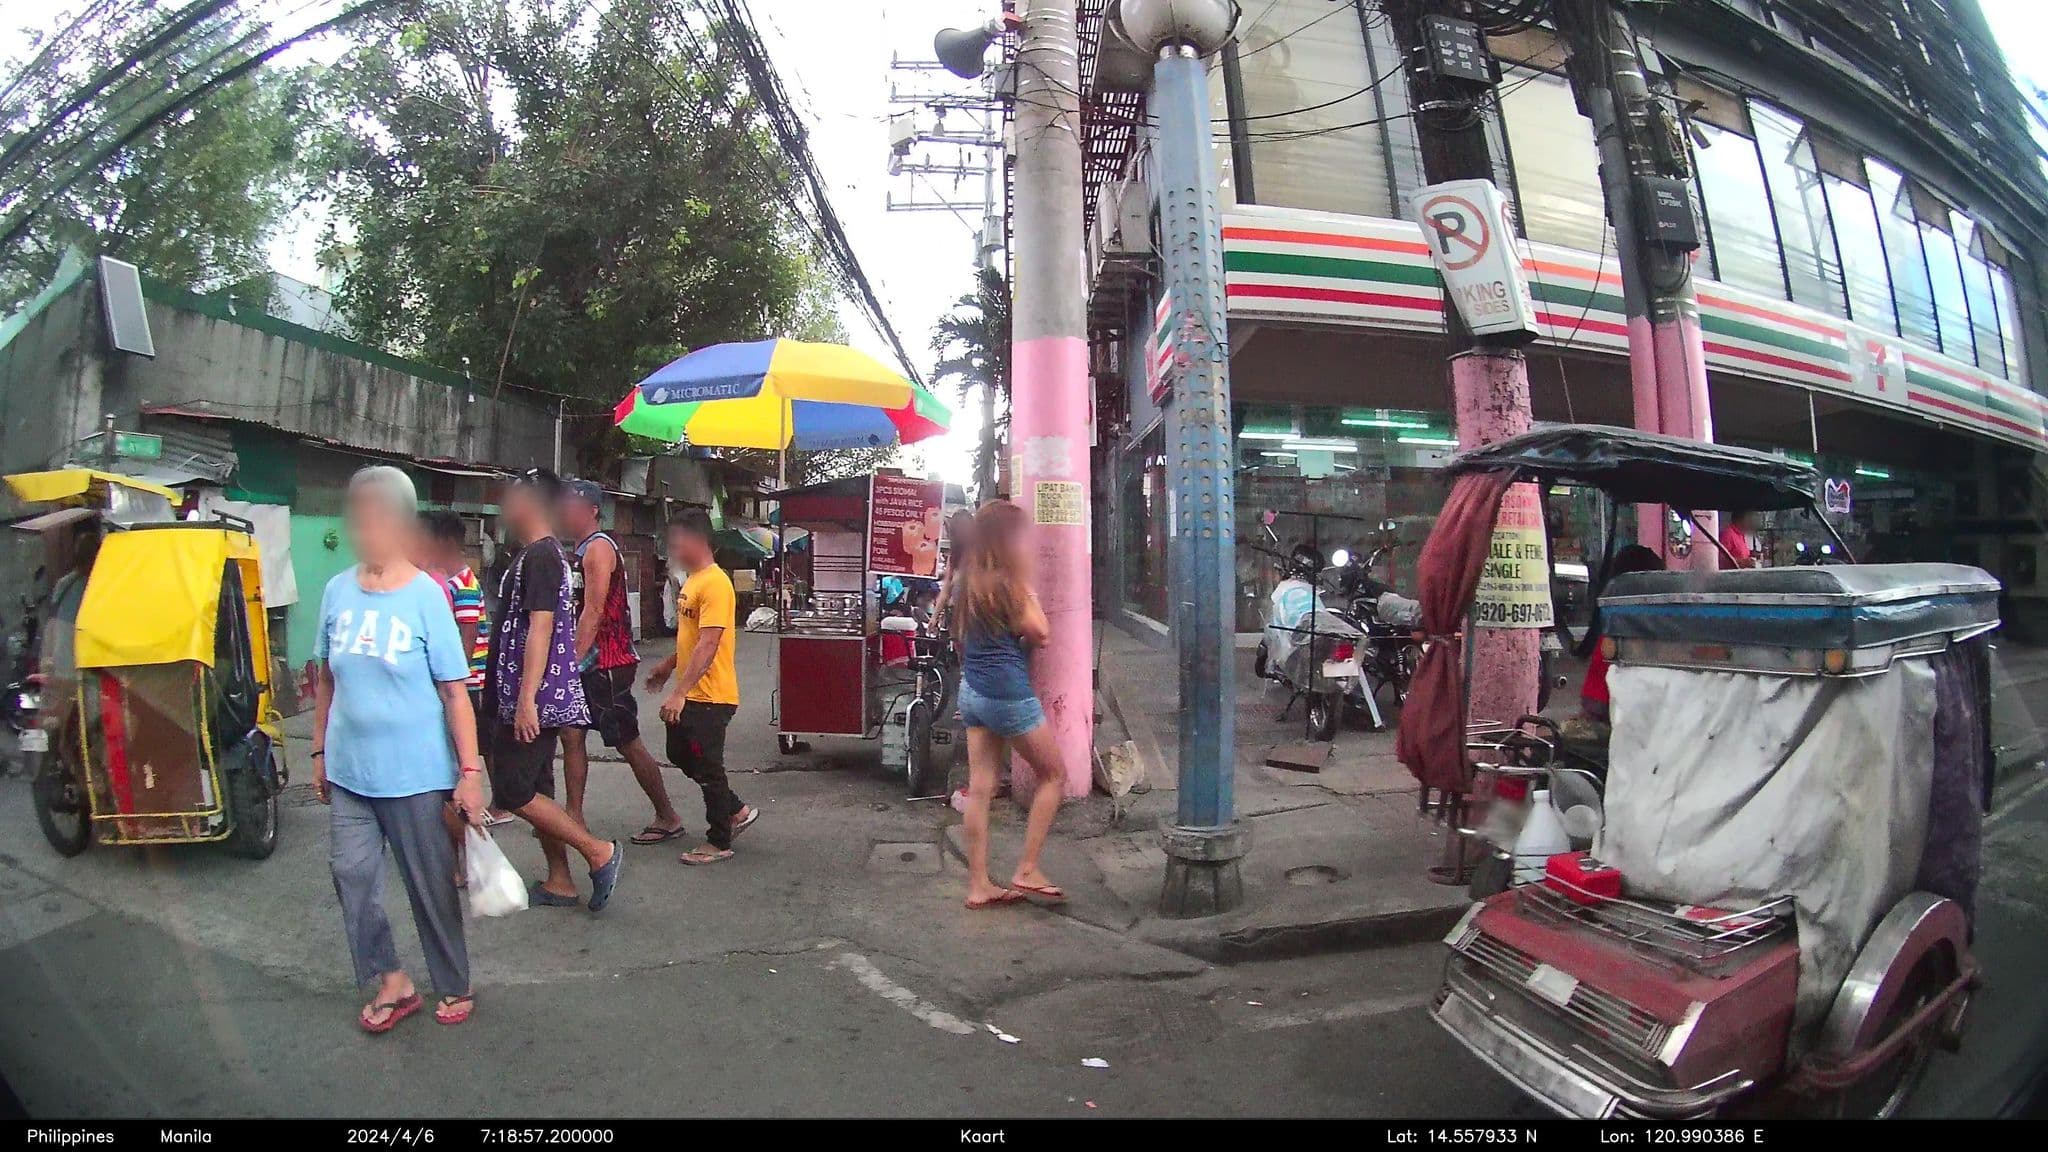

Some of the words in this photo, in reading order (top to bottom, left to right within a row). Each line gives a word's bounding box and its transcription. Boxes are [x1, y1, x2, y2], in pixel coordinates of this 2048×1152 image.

[1456, 280, 1506, 302] KING
[670, 383, 740, 400] MICROMATIC
[893, 487, 918, 497] SIOMAI
[889, 498, 907, 507] JAVA
[907, 499, 923, 508] RICE
[883, 508, 905, 517] PESOS
[905, 509, 924, 519] ONLY
[873, 546, 889, 555] PORK
[1515, 544, 1522, 559] &
[1483, 562, 1521, 579] SINGLE
[328, 609, 412, 666] GAP
